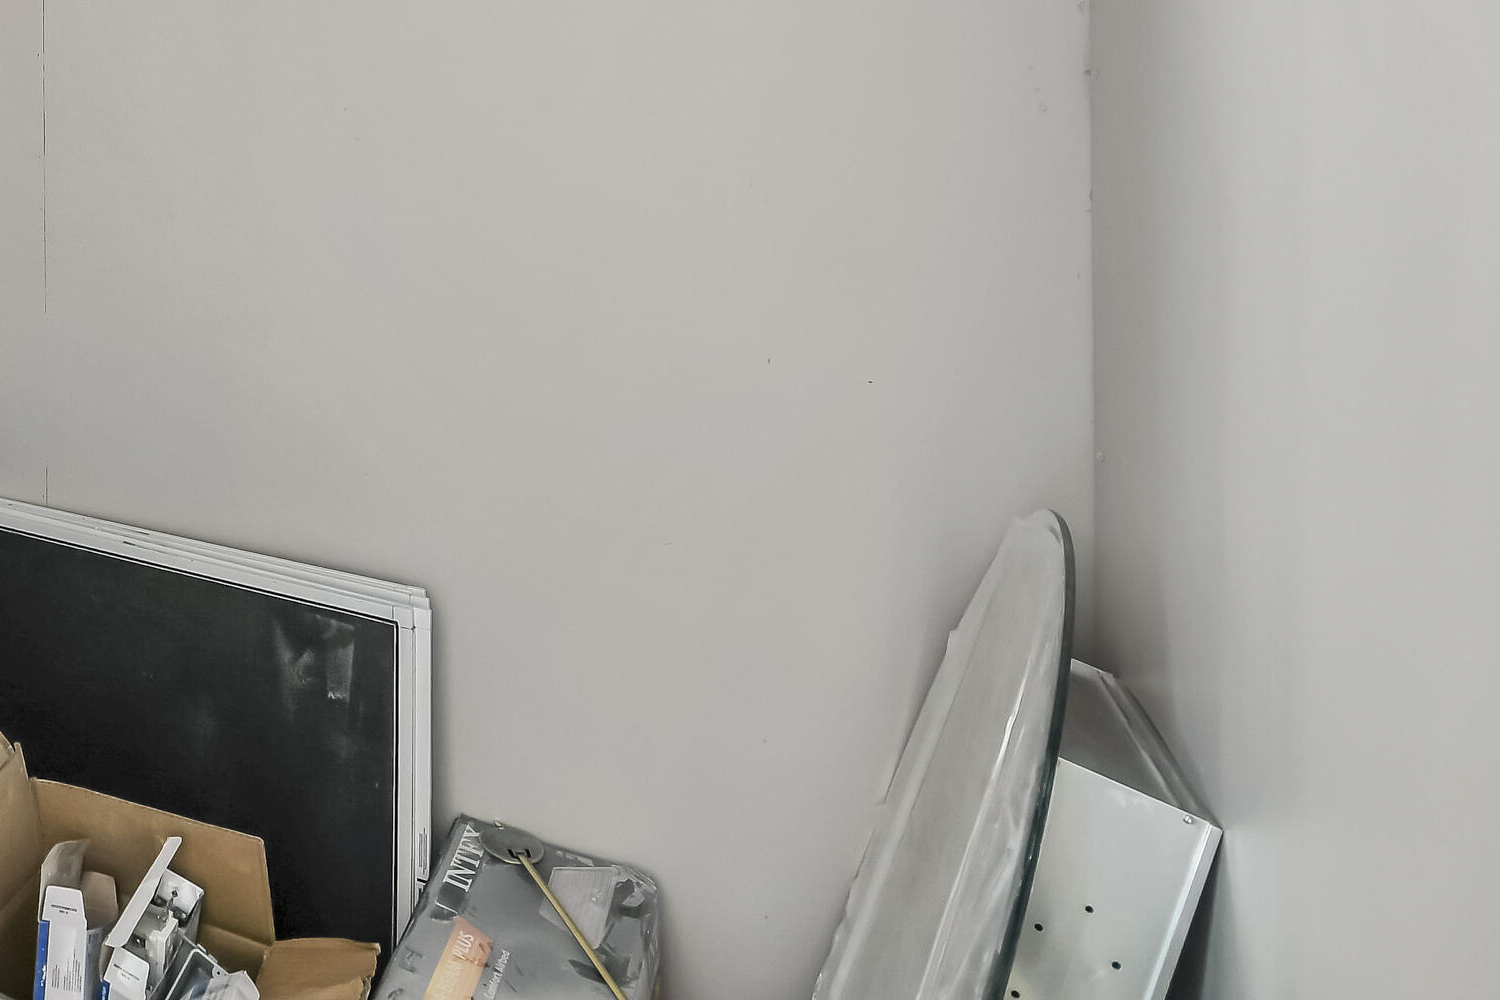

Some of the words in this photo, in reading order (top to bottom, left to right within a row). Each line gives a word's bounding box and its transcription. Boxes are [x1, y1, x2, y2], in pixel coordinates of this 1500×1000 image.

[443, 824, 485, 893] INTEX
[453, 930, 475, 961] PLUS
[484, 968, 504, 1000] Comfort
[495, 949, 511, 975] Airbed
